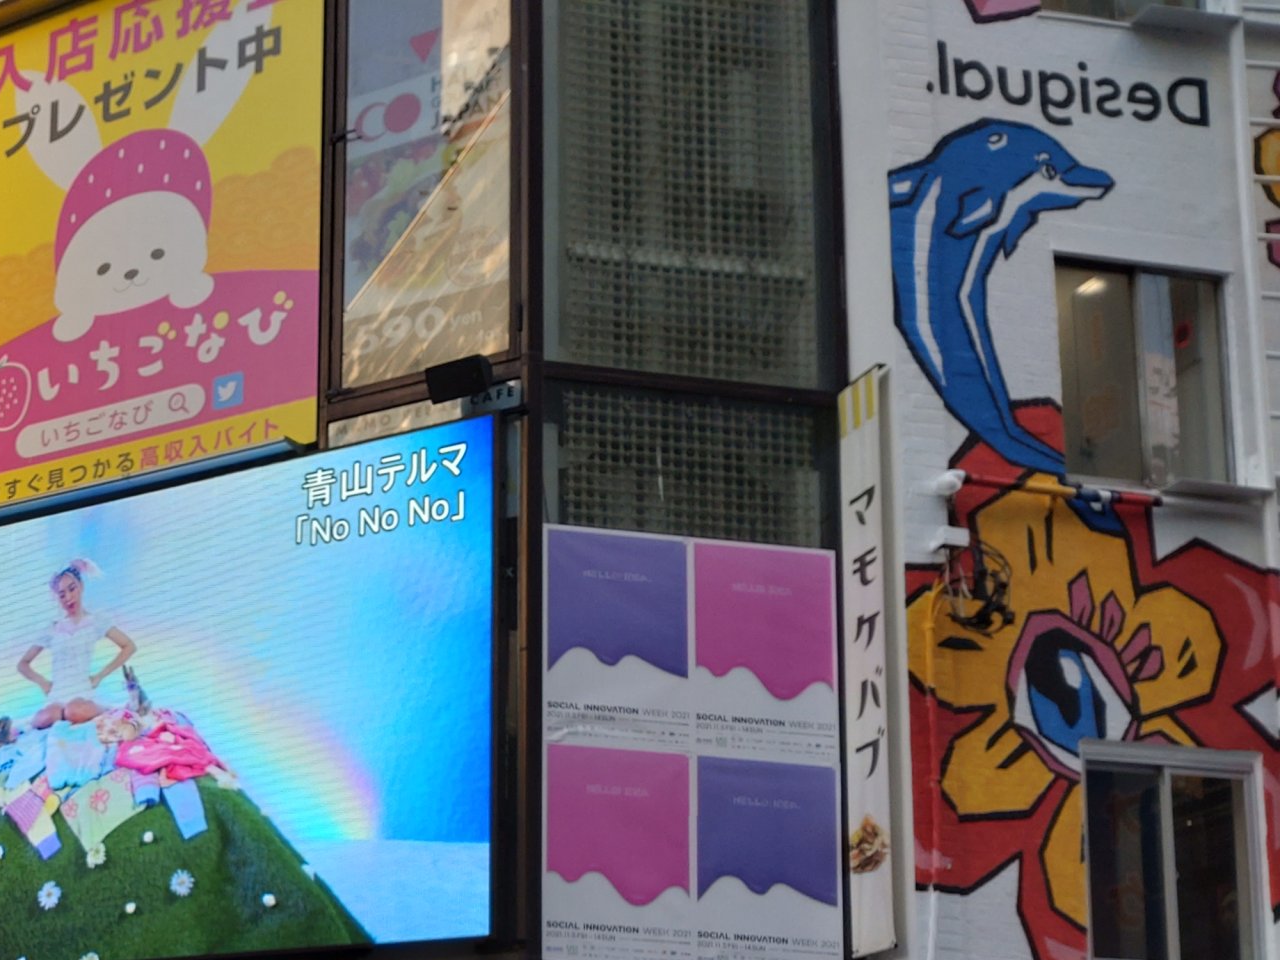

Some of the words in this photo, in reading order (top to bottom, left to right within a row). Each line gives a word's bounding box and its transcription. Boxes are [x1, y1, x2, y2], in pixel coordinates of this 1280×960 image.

[0, 23, 283, 160] プレゼント中
[37, 290, 294, 402] いちごなび
[40, 401, 154, 448] いちごなび
[301, 443, 468, 509] 青山テルマ
[359, 505, 400, 538] No
[847, 485, 885, 780] マモケバブ
[547, 700, 580, 711] SOCIAL
[584, 704, 639, 715] INNOVATION
[696, 713, 728, 722] SOCIAL
[731, 716, 786, 727] INNOVATION
[546, 920, 580, 930] SOCIAL
[583, 924, 639, 934] INNOVATION
[642, 927, 669, 937] WEEK
[697, 931, 730, 940] SOCIAL
[734, 934, 788, 945] INNOVATION
